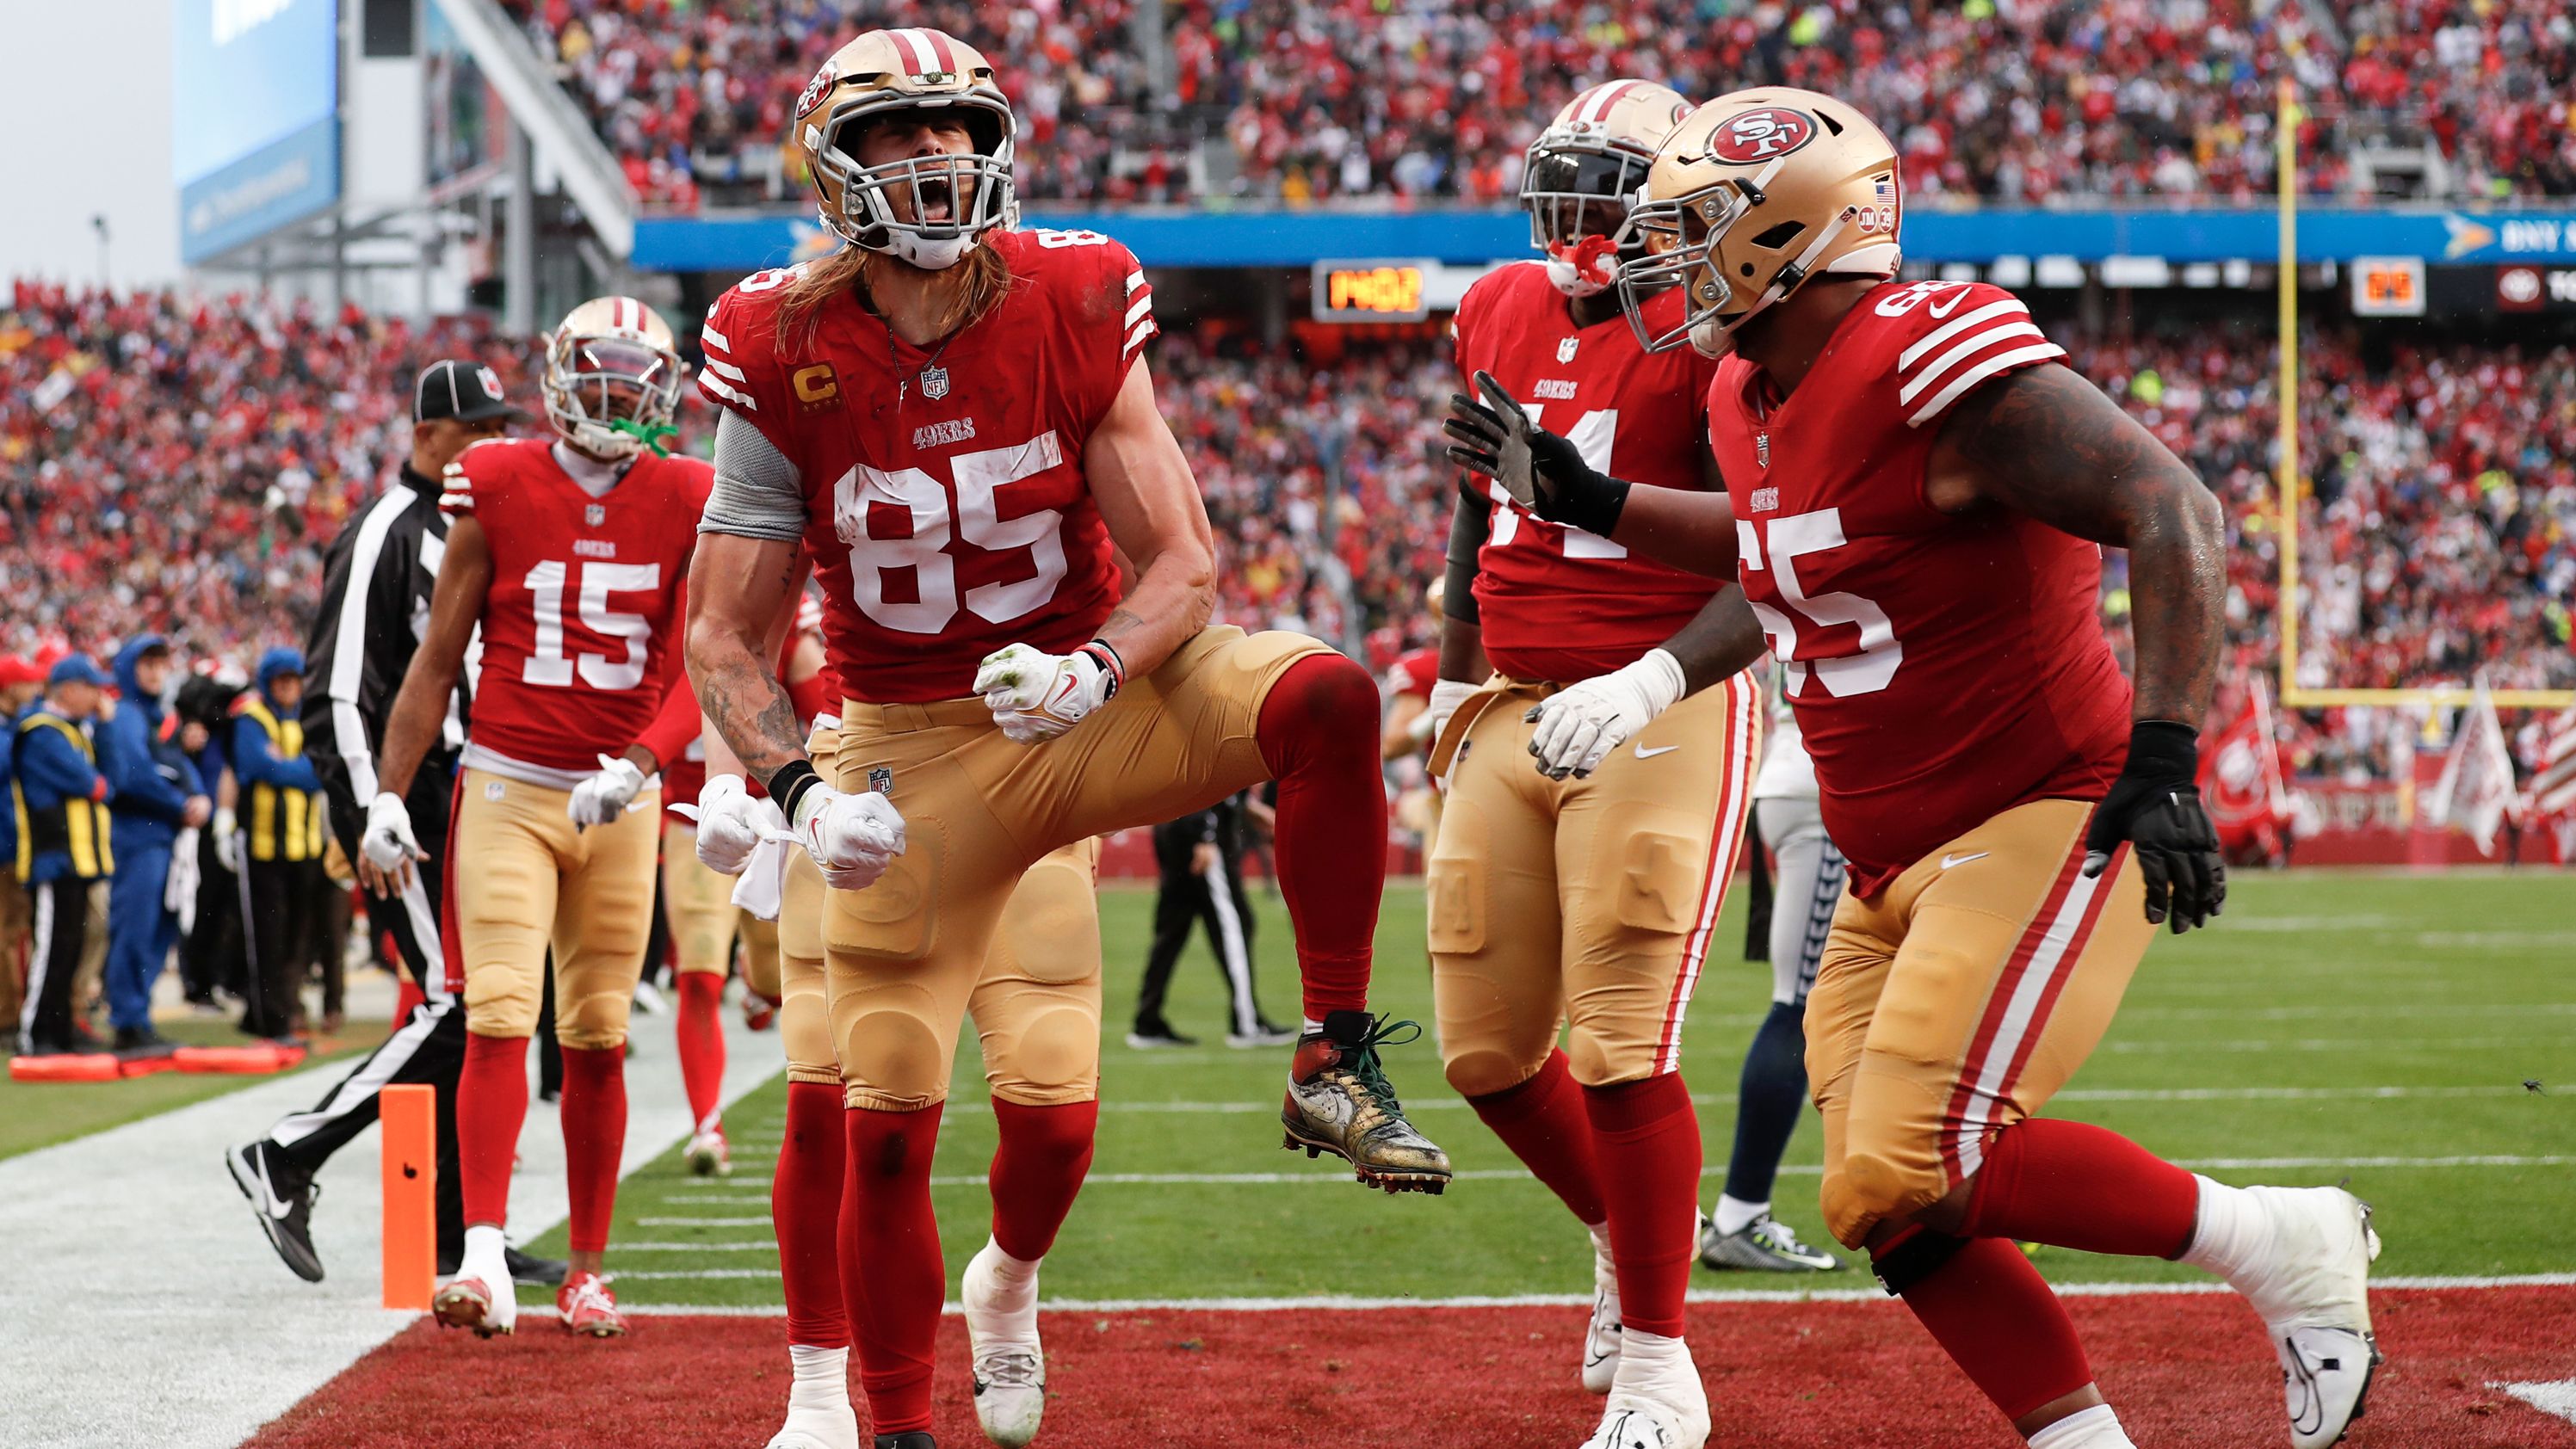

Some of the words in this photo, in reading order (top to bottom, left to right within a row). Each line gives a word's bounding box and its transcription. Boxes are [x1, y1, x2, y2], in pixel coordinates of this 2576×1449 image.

[1732, 112, 1799, 157] SF
[1859, 212, 1875, 226] JM
[1881, 211, 1892, 227] 39
[793, 365, 837, 403] C
[912, 417, 975, 450] 49ERS
[834, 429, 1067, 634] 85
[522, 559, 660, 690] 15
